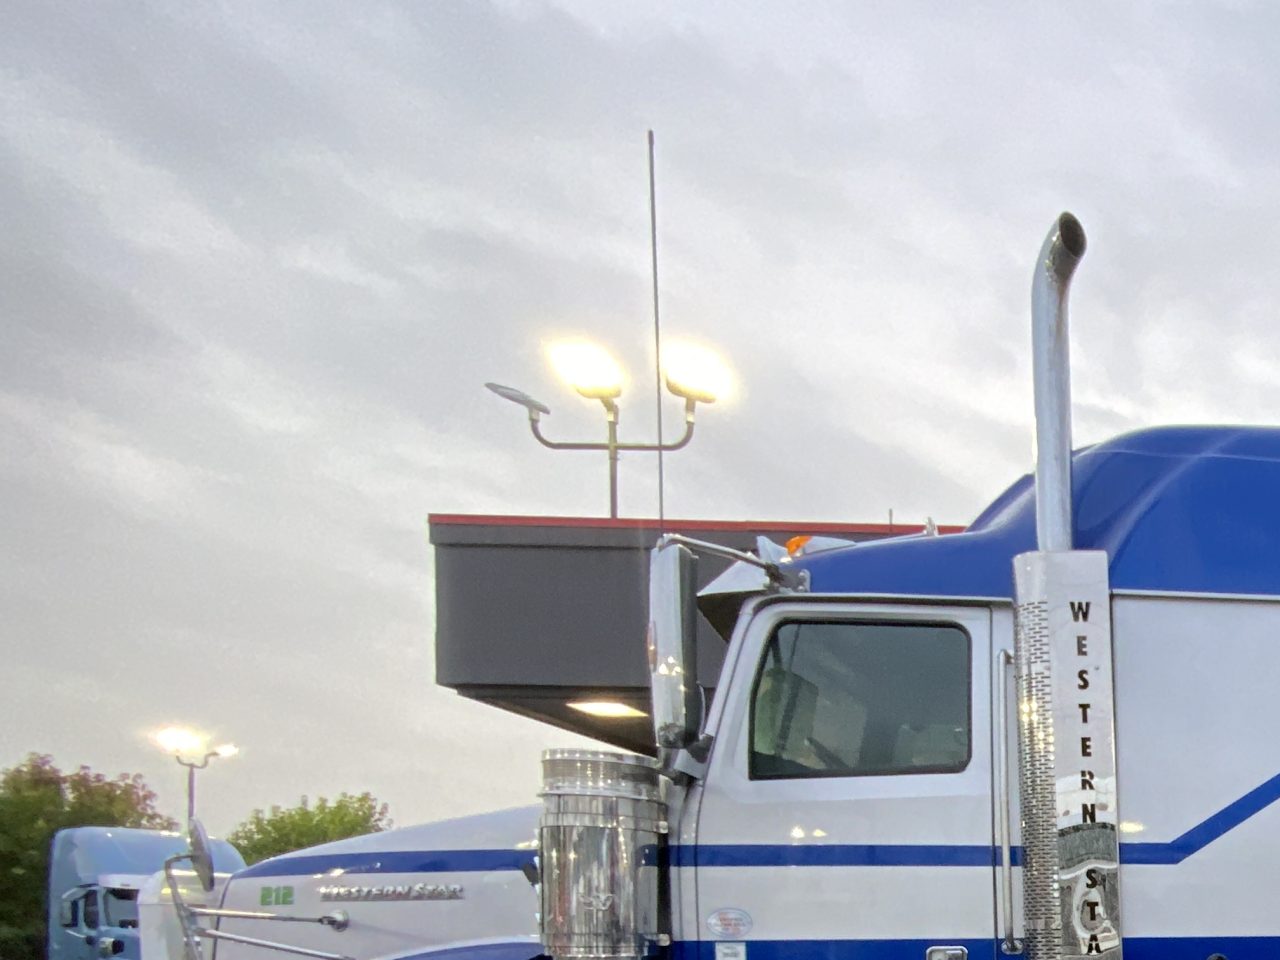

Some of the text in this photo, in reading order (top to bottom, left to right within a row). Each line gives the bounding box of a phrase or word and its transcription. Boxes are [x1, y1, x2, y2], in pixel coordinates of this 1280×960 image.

[1069, 601, 1097, 824] WESTERN
[259, 885, 295, 906] 212
[411, 882, 464, 900] STAR
